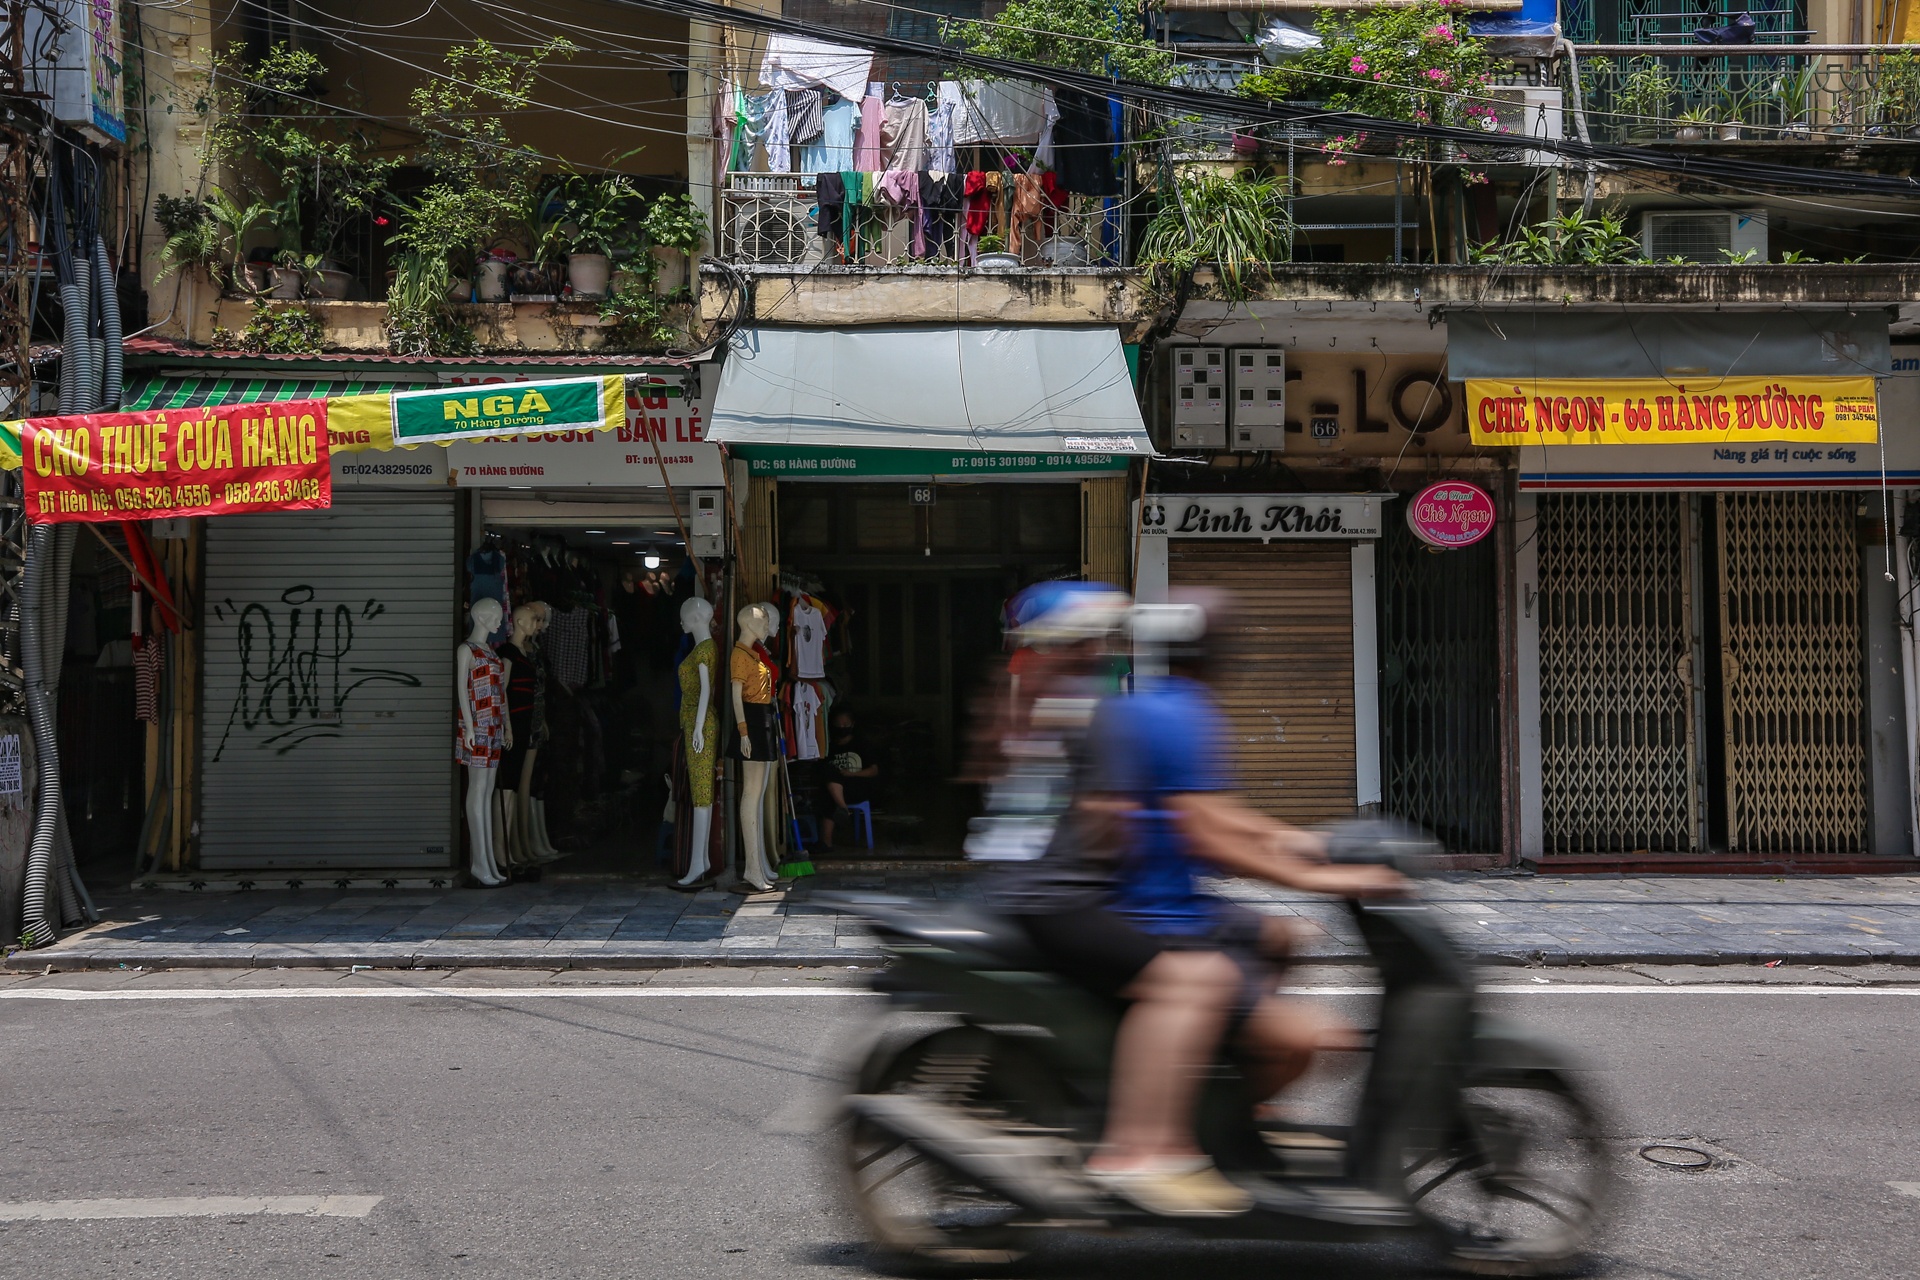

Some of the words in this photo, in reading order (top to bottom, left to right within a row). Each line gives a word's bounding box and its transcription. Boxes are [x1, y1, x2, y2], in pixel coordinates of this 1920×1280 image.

[443, 389, 552, 421] NGÀ
[1478, 386, 1529, 434] CHÈ
[1533, 396, 1606, 433] NGON
[1624, 398, 1652, 431] 66
[1656, 385, 1731, 432] HÀNG
[1735, 383, 1825, 431] ĐƯỜNG
[454, 420, 467, 429] 70
[470, 416, 501, 430] Hàng
[503, 413, 544, 428] Đường
[676, 406, 703, 443] LẺ
[1313, 420, 1337, 436] 66
[33, 427, 91, 478] CHO
[100, 413, 169, 475] THUÊ
[176, 406, 234, 472] CỬA
[241, 407, 318, 469] HÀNG
[625, 454, 641, 464] ĐT:
[752, 459, 771, 470] ĐC:
[773, 459, 786, 469] 68
[788, 457, 818, 469] HÀNG
[820, 456, 857, 469] ĐƯỜNG
[952, 457, 968, 468] ĐT:
[971, 457, 996, 467] 0915
[999, 456, 1037, 467] 301990
[1046, 455, 1072, 466] 0914
[1074, 454, 1113, 465] 495624
[1713, 447, 1746, 464] Nâng
[1750, 447, 1770, 464] giá
[1774, 449, 1789, 463] trị
[1792, 449, 1823, 464] cuộc
[1827, 446, 1857, 463] sống
[464, 467, 477, 476] 70
[479, 463, 508, 476] HÀNG
[509, 463, 545, 476] ĐƯỜNG
[38, 490, 55, 514] ĐT
[59, 487, 88, 513] liên
[91, 487, 113, 516] hệ:
[116, 484, 211, 510] 056.526.4556
[914, 489, 931, 502] 68
[1175, 505, 1253, 534] Linh
[1260, 504, 1344, 534] Khôi
[1417, 503, 1447, 523] Chè
[1448, 503, 1491, 532] Ngon
